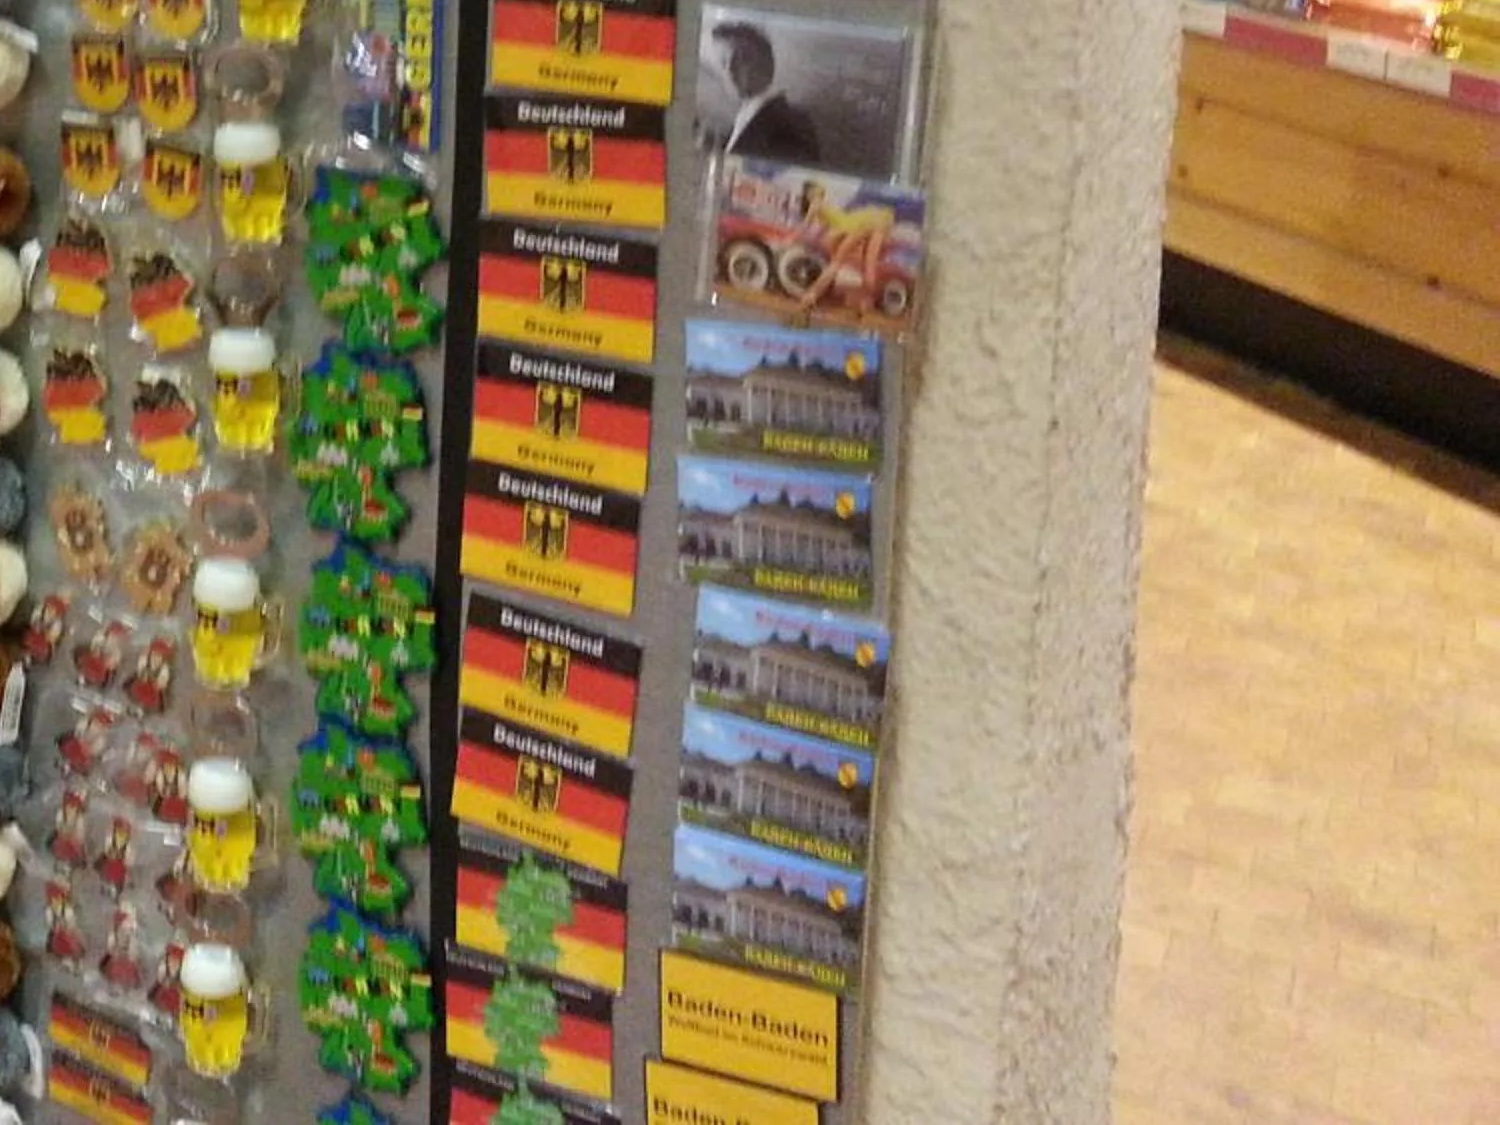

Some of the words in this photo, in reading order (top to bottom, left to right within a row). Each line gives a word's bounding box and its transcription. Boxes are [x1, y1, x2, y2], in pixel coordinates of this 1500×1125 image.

[517, 100, 626, 127] Deutschland
[513, 227, 620, 264] Deutschland
[509, 352, 616, 393] Deutschland
[498, 471, 603, 516] Deutschland
[500, 607, 604, 659] Deutschland
[493, 723, 597, 779] Deutschland
[667, 989, 830, 1049] Baden-Baden
